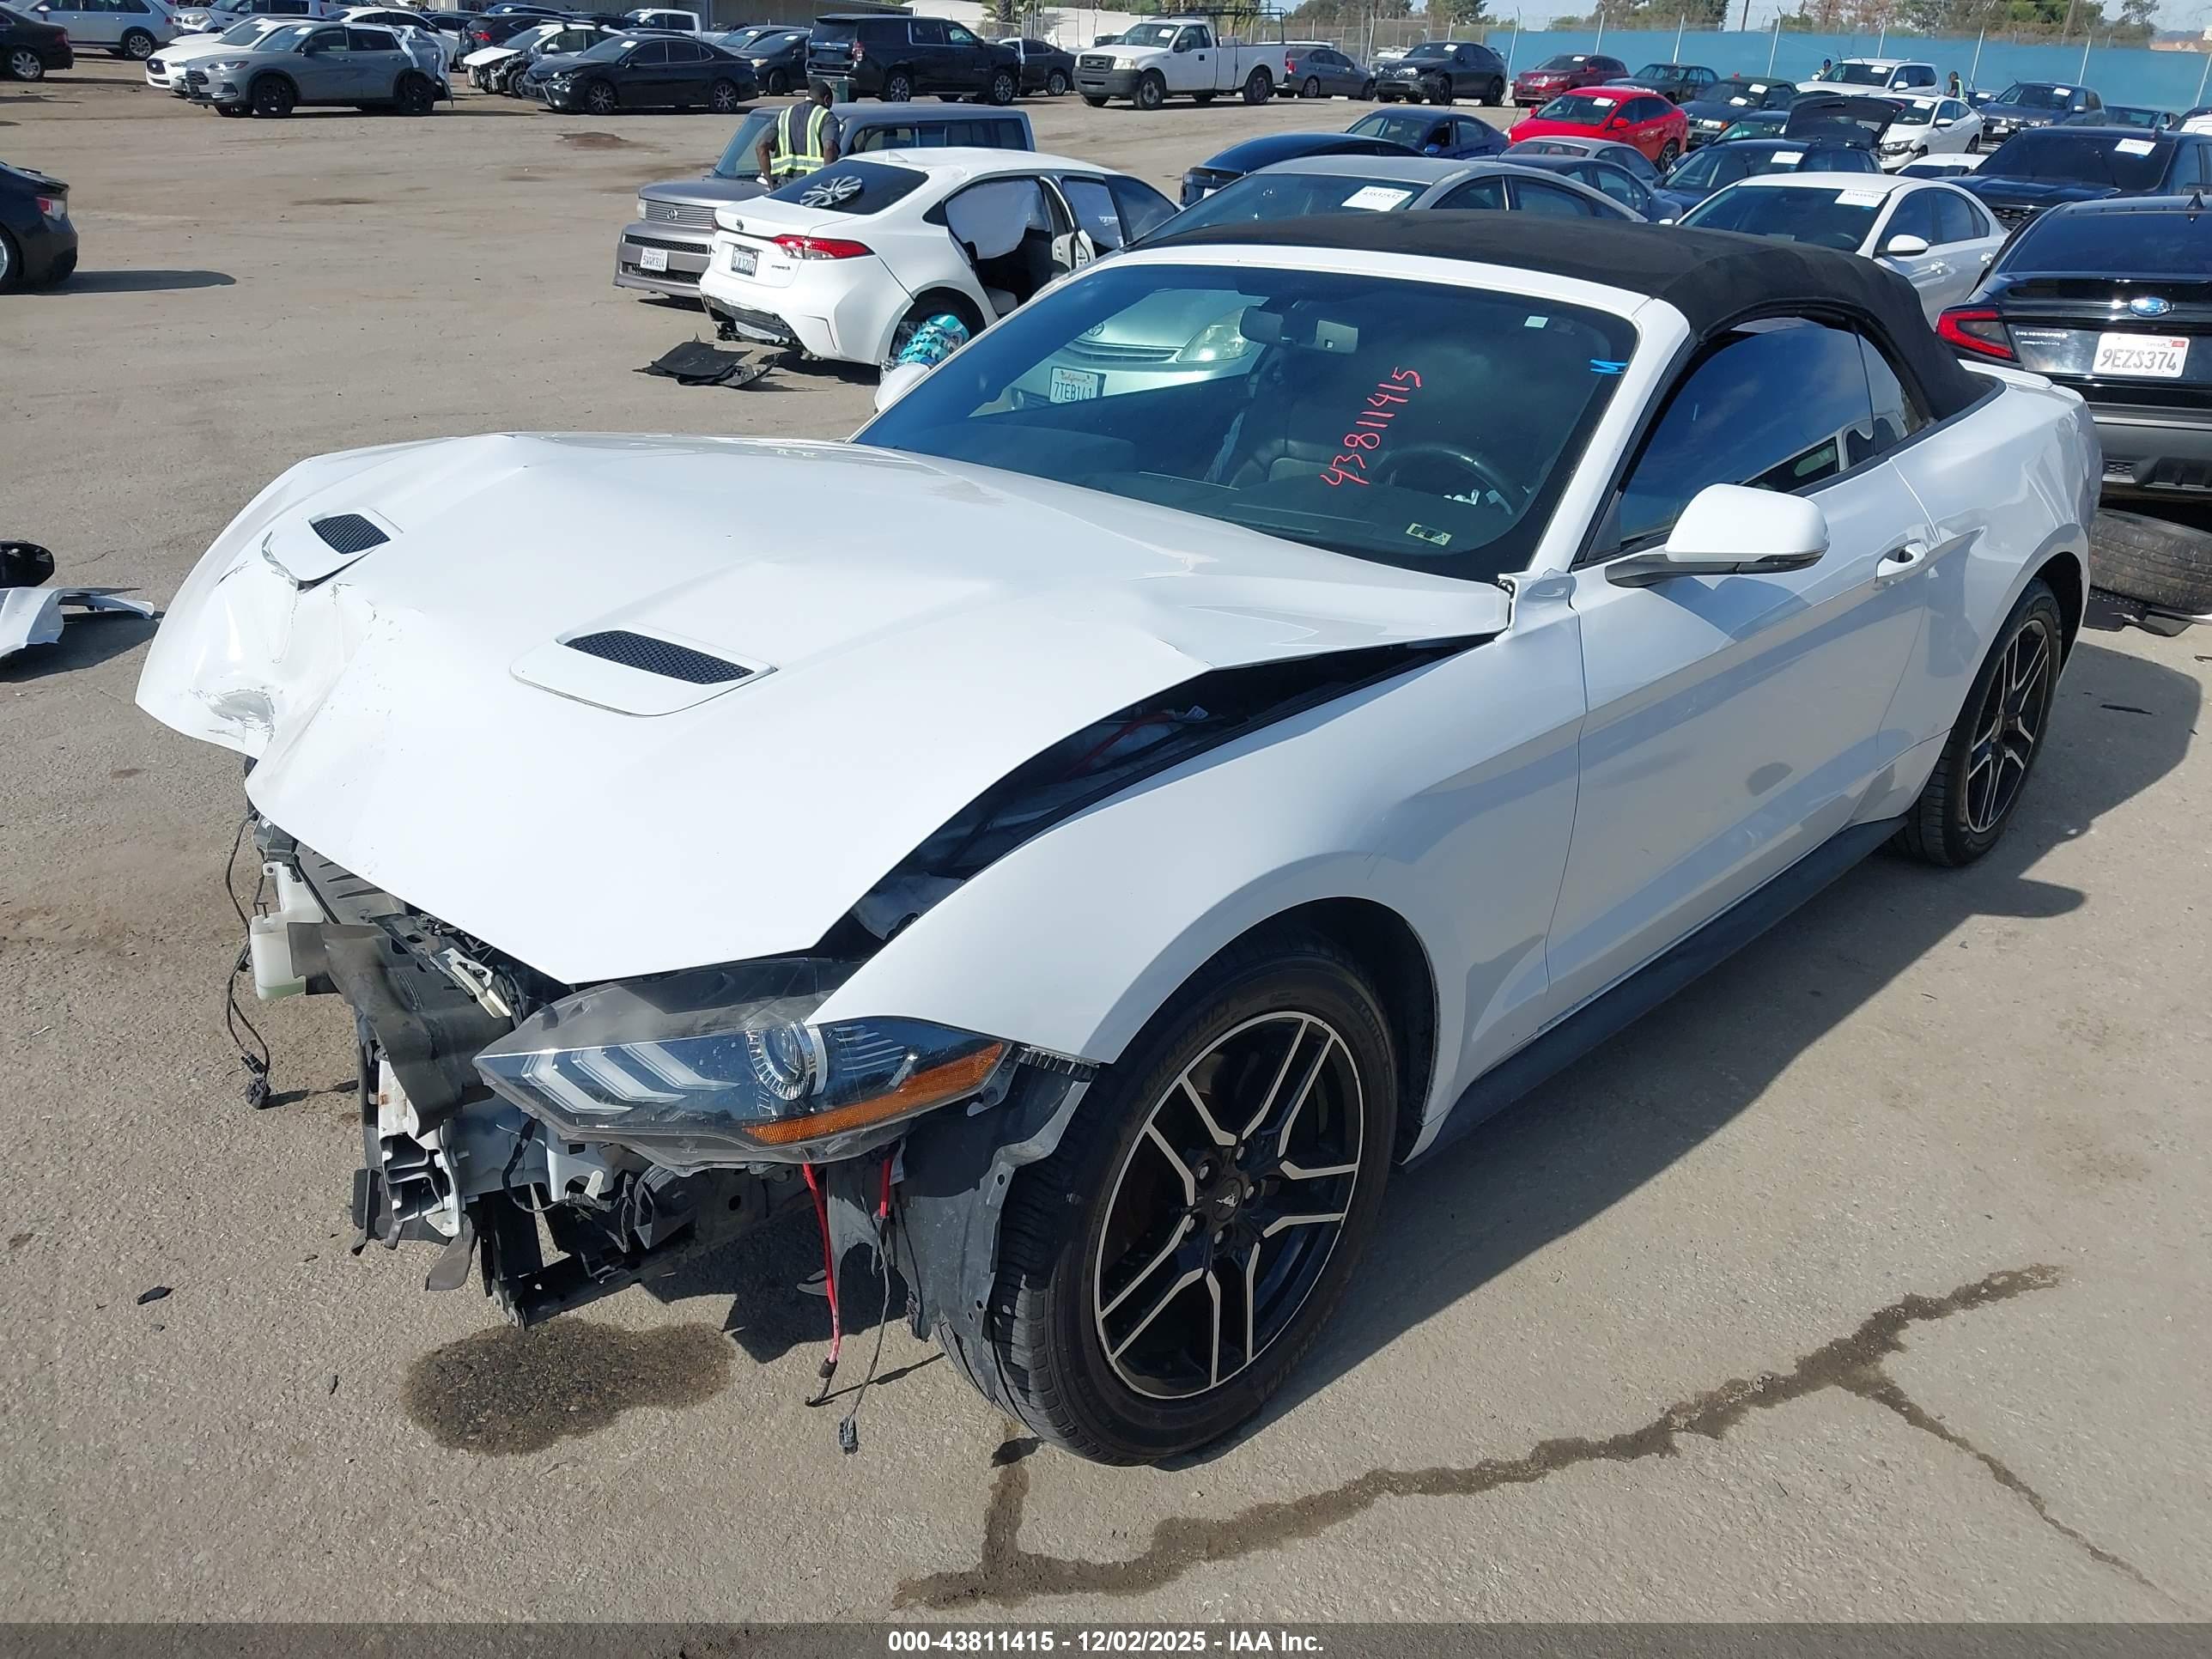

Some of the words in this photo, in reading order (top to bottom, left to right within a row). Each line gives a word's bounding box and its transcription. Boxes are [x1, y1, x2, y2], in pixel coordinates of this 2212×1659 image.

[2100, 348, 2178, 371] 9EZS374
[1054, 381, 1092, 401] 7TEB141
[1320, 367, 1422, 486] 43811415
